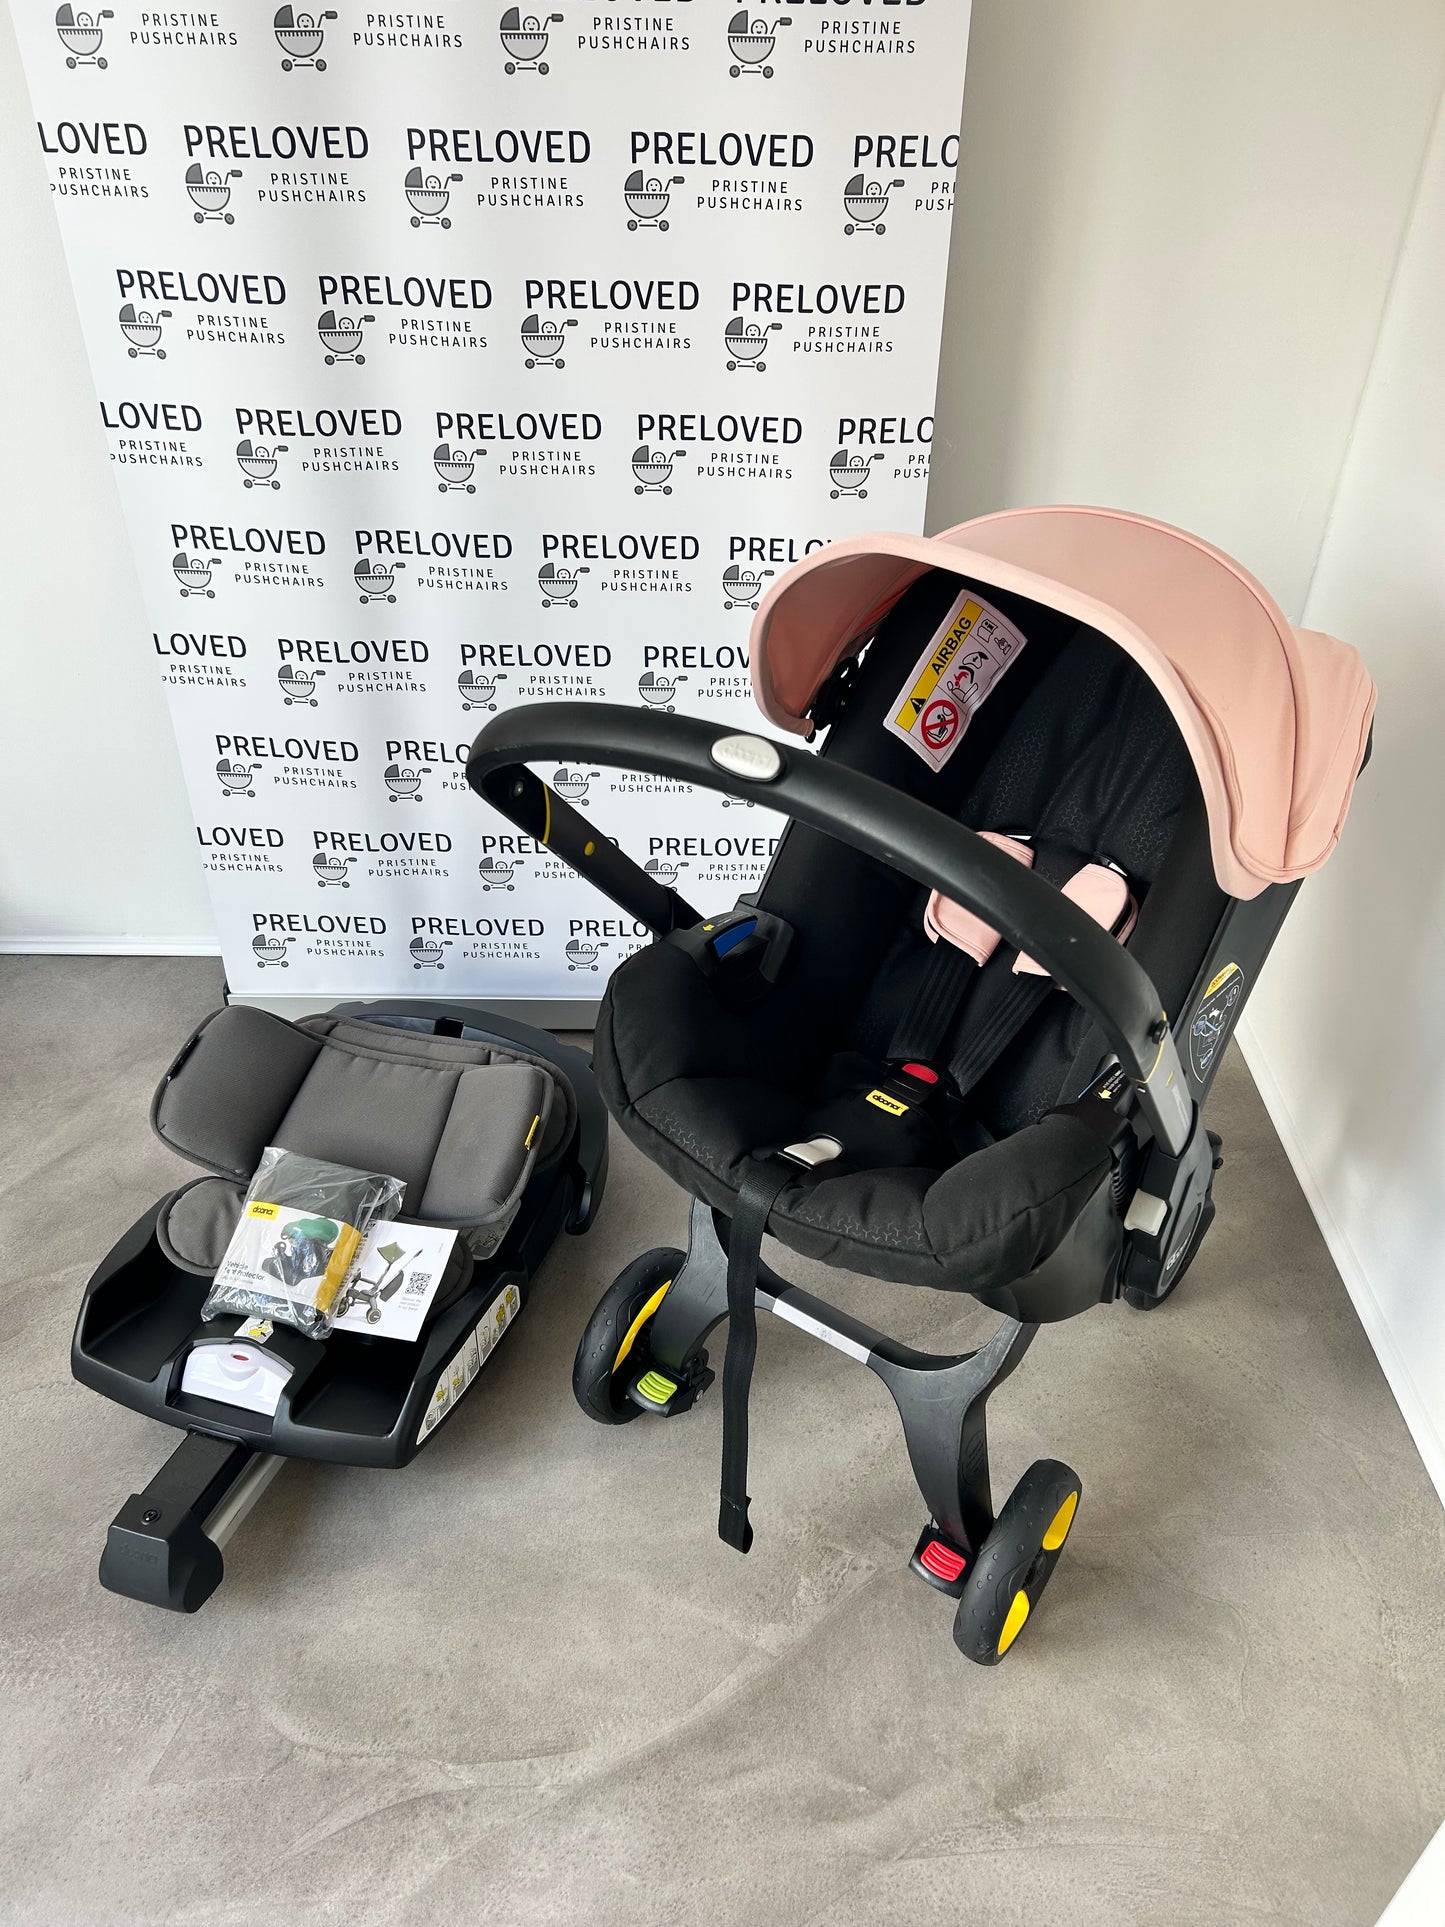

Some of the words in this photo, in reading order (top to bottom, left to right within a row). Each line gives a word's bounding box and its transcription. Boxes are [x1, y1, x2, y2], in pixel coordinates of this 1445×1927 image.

[142, 13, 219, 26] PRISTINE
[367, 14, 445, 28] PRISTINE
[594, 17, 673, 31] PRISTINE
[821, 21, 900, 34] PRISTINE
[130, 32, 237, 45] PUSHCHAIRS
[353, 33, 462, 47] PUSHCHAIRS
[578, 36, 689, 50] PUSHCHAIRS
[805, 40, 915, 53] PUSHCHAIRS
[37, 122, 147, 155] LOVED
[184, 125, 368, 159] PRELOVED
[407, 128, 590, 163] PRELOVED
[631, 131, 813, 167] PRELOVED
[854, 135, 959, 168] PRELO
[59, 167, 131, 180] PRISTINE
[271, 173, 349, 185] PRISTINE
[491, 177, 567, 189] PRISTINE
[713, 180, 787, 193] PRISTINE
[258, 190, 366, 202] PUSHCHAIRS
[478, 194, 583, 207] PUSHCHAIRS
[698, 196, 802, 211] PUSHCHAIRS
[116, 269, 286, 305] PRELOVED
[319, 276, 492, 309] PRELOVED
[526, 280, 699, 310] PRELOVED
[733, 282, 905, 314] PRELOVED
[197, 315, 268, 328] PRISTINE
[401, 319, 471, 332] PRISTINE
[605, 322, 676, 333] PRISTINE
[187, 329, 285, 344] PUSHCHAIRS
[809, 327, 879, 337] PRISTINE
[389, 333, 487, 347] PUSHCHAIRS
[591, 337, 690, 349] PUSHCHAIRS
[794, 341, 892, 352] PUSHCHAIRS
[100, 401, 202, 431] LOVED
[236, 408, 402, 437] PRELOVED
[436, 412, 601, 440] PRELOVED
[638, 414, 802, 444] PRELOVED
[839, 417, 934, 444] PRELO
[119, 440, 187, 452] PRISTINE
[314, 447, 384, 458] PRISTINE
[512, 451, 581, 461] PRISTINE
[711, 453, 779, 464] PRISTINE
[302, 461, 398, 472] PUSHCHAIRS
[500, 465, 595, 475] PUSHCHAIRS
[698, 466, 792, 479] PUSHCHAIRS
[171, 524, 325, 555] PRELOVED
[355, 530, 512, 558] PRELOVED
[542, 534, 699, 560] PRELOVED
[730, 536, 832, 563] PREL
[245, 562, 309, 574] PRISTINE
[429, 566, 493, 578] PRISTINE
[614, 570, 678, 579] PRISTINE
[235, 574, 324, 587] PUSHCHAIRS
[418, 578, 507, 590] PUSHCHAIRS
[602, 582, 691, 592] PUSHCHAIRS
[153, 633, 246, 658] LOVED
[278, 639, 429, 663] PRELOVED
[931, 617, 972, 676] AIRBAG
[461, 644, 611, 667] PRELOVED
[644, 646, 750, 668] PRELOV
[170, 664, 232, 675] PRISTINE
[349, 671, 412, 681] PRISTINE
[530, 676, 592, 684] PRISTINE
[710, 677, 752, 686] PRIST
[338, 682, 426, 692] PUSHCHAIRS
[519, 687, 605, 696] PUSHCHAIRS
[698, 689, 751, 698] PUSHCH
[216, 735, 358, 762] PRELOVED
[386, 740, 472, 764] PRELO
[284, 767, 343, 777] PRISTINE
[274, 777, 356, 788] PUSHCHAIRS
[611, 784, 692, 793] PUSHCHAIRS
[197, 827, 284, 847] LOVED
[313, 831, 452, 852] PRELOVED
[212, 854, 269, 862] PRISTINE
[378, 859, 436, 868] PRISTINE
[369, 868, 448, 877] PUSHCHAIRS
[698, 873, 764, 881] PUSHCHAI
[253, 914, 386, 934] PRELOVED
[412, 917, 544, 936] PRELOVED
[569, 919, 650, 937] PRELO
[316, 939, 372, 947] PRISTINE
[307, 948, 384, 957] PUSHCHAIRS
